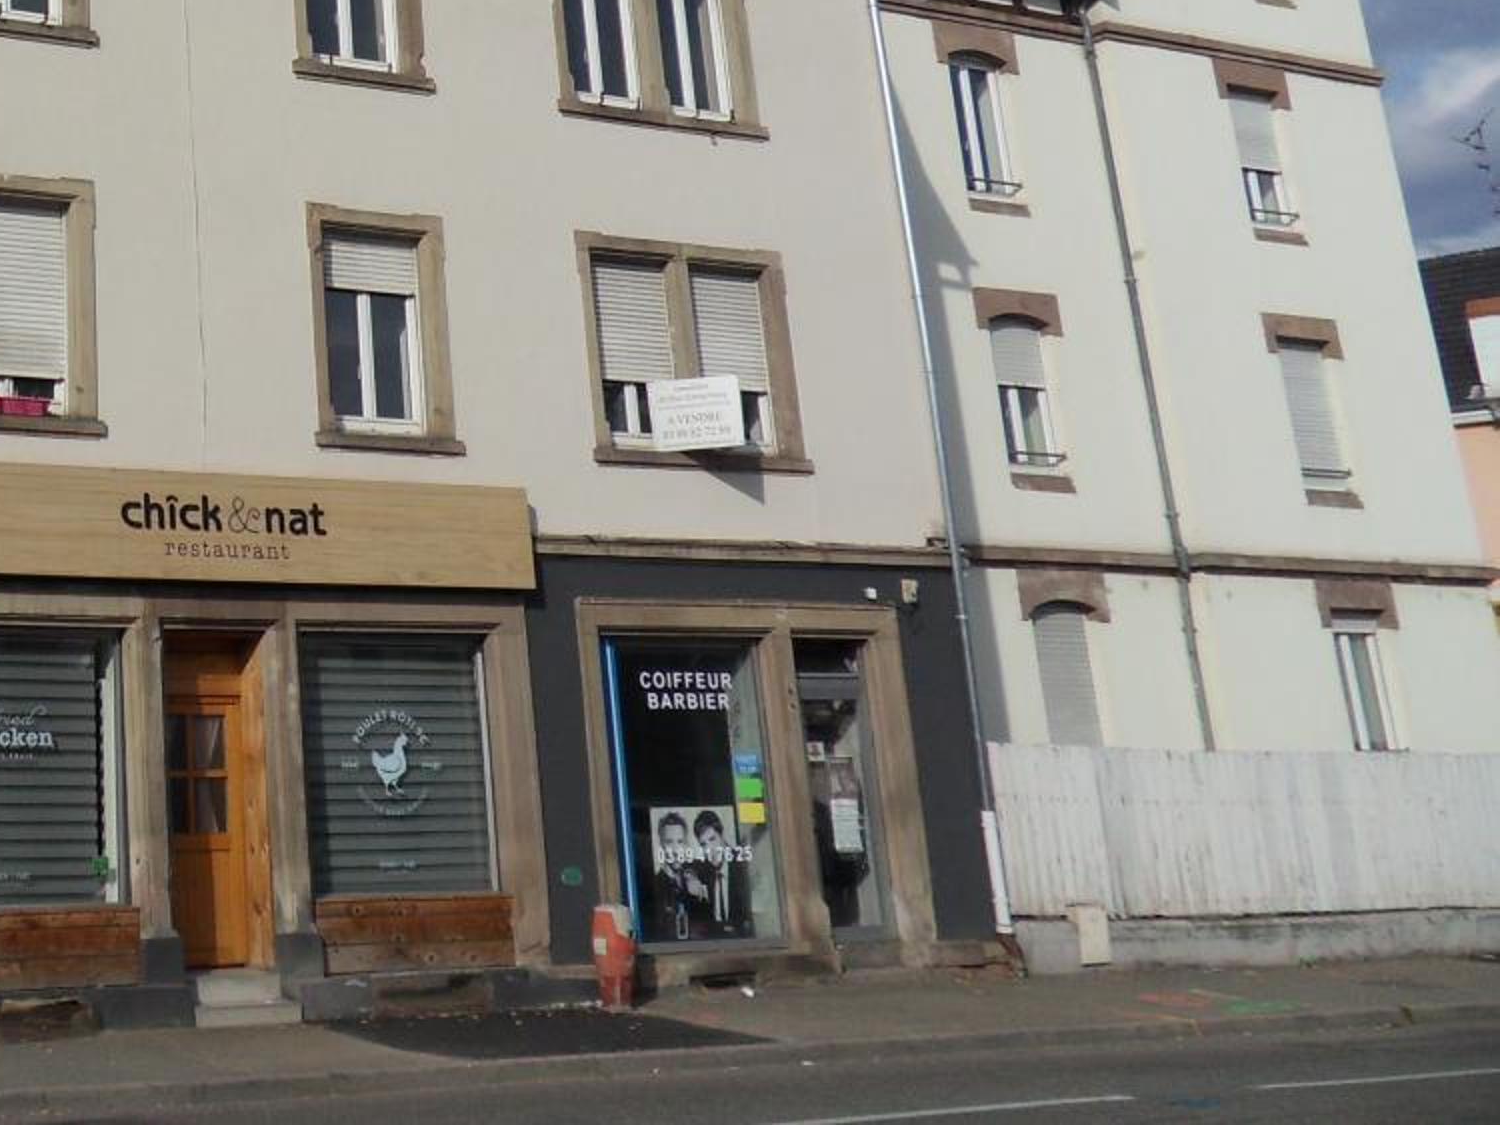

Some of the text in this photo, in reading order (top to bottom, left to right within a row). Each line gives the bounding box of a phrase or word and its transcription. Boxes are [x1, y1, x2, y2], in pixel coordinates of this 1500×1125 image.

[164, 541, 290, 560] restaurant
[639, 671, 733, 690] COIFFEUR
[647, 692, 730, 710] BARBIER
[352, 709, 387, 744] POULET
